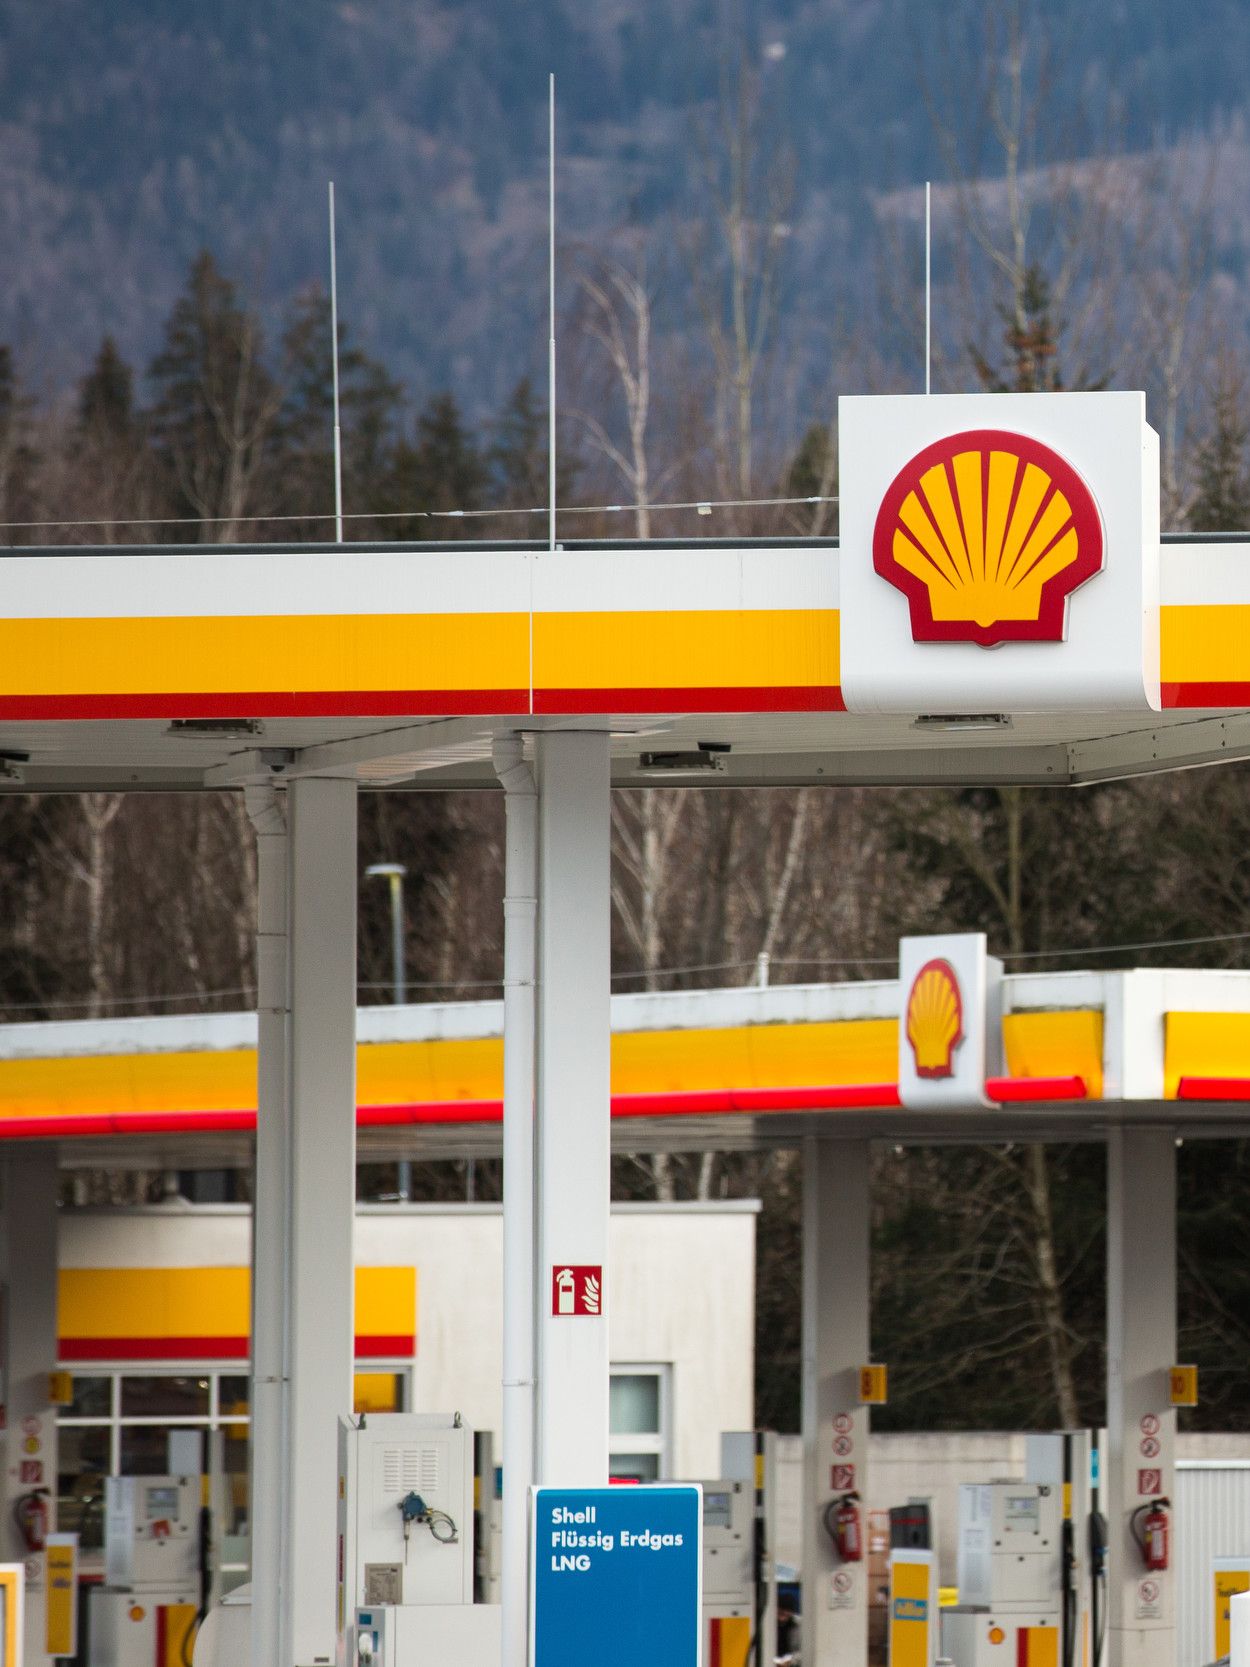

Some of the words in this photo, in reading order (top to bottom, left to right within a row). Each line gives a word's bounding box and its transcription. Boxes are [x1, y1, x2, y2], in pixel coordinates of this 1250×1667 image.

[551, 1506, 596, 1524] Shell
[551, 1530, 614, 1551] Flüssig
[620, 1529, 683, 1551] Erdgas
[551, 1555, 591, 1571] LNG
